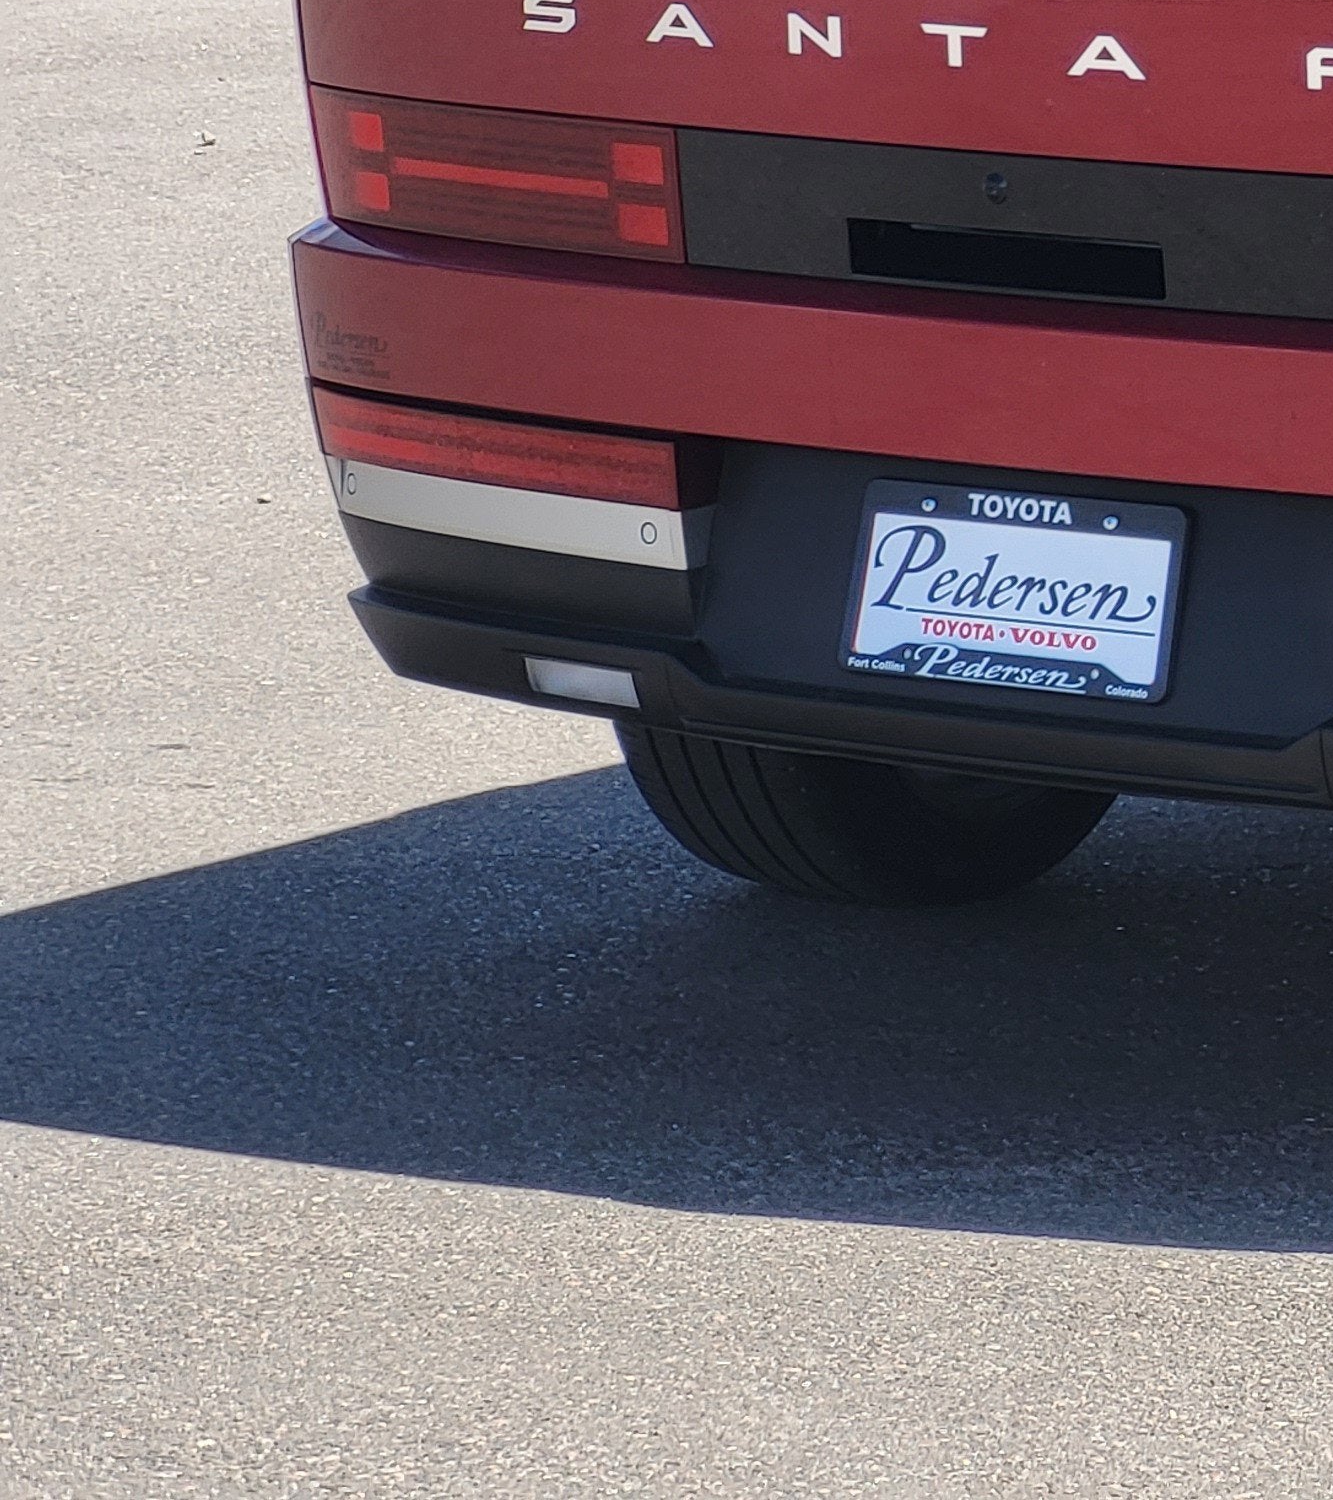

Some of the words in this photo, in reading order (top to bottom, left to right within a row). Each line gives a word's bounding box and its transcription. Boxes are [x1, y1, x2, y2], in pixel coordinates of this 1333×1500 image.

[968, 493, 1072, 525] TOYOTA
[871, 525, 1157, 622] Pedersen
[921, 618, 994, 641] TOYOTA
[1010, 627, 1097, 651] VOLVO
[848, 657, 869, 670] Fort
[871, 659, 905, 672] Collins
[914, 644, 1087, 688] Pedersen
[1105, 684, 1148, 699] Colorado
